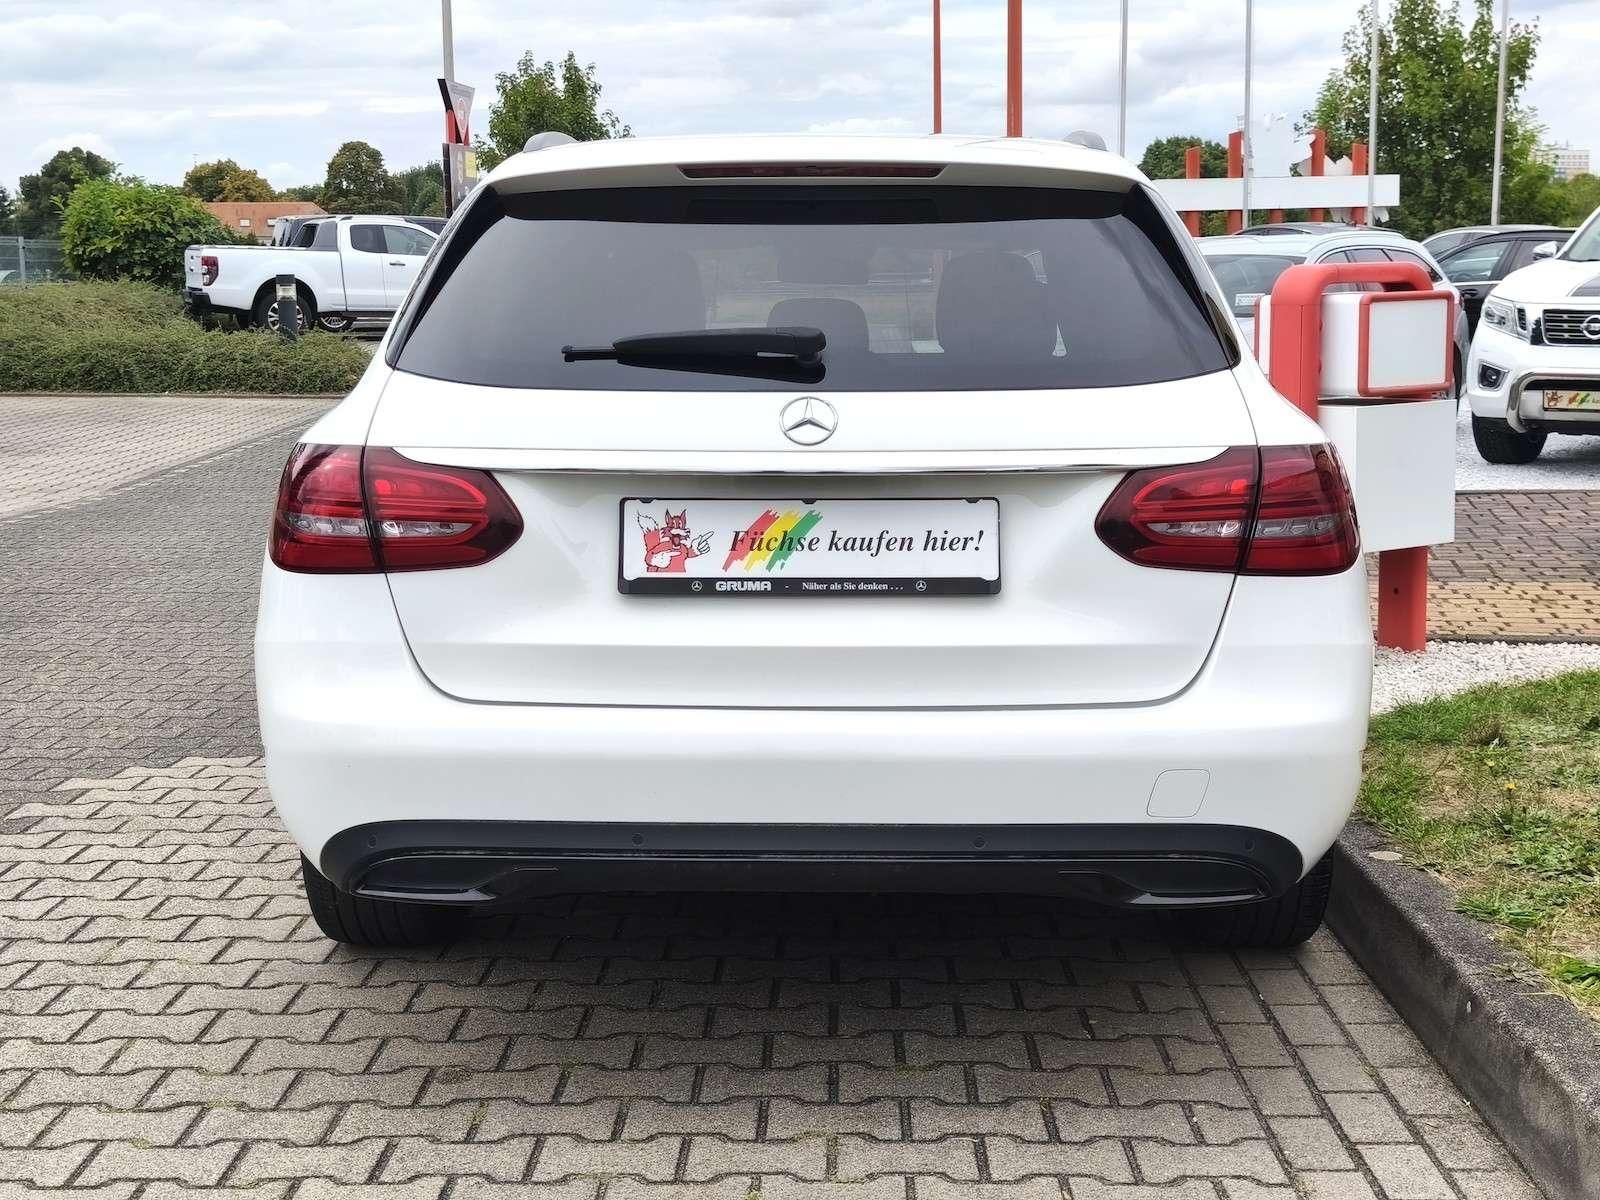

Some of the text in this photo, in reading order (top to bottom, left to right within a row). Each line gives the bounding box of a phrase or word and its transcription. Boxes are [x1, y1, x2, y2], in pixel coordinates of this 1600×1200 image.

[729, 530, 984, 557] Füchse kaufen hier!
[715, 580, 772, 592] GRUMA
[801, 581, 829, 591] Näher
[829, 582, 842, 591] als
[843, 582, 857, 591] Sie
[857, 582, 889, 591] denken
